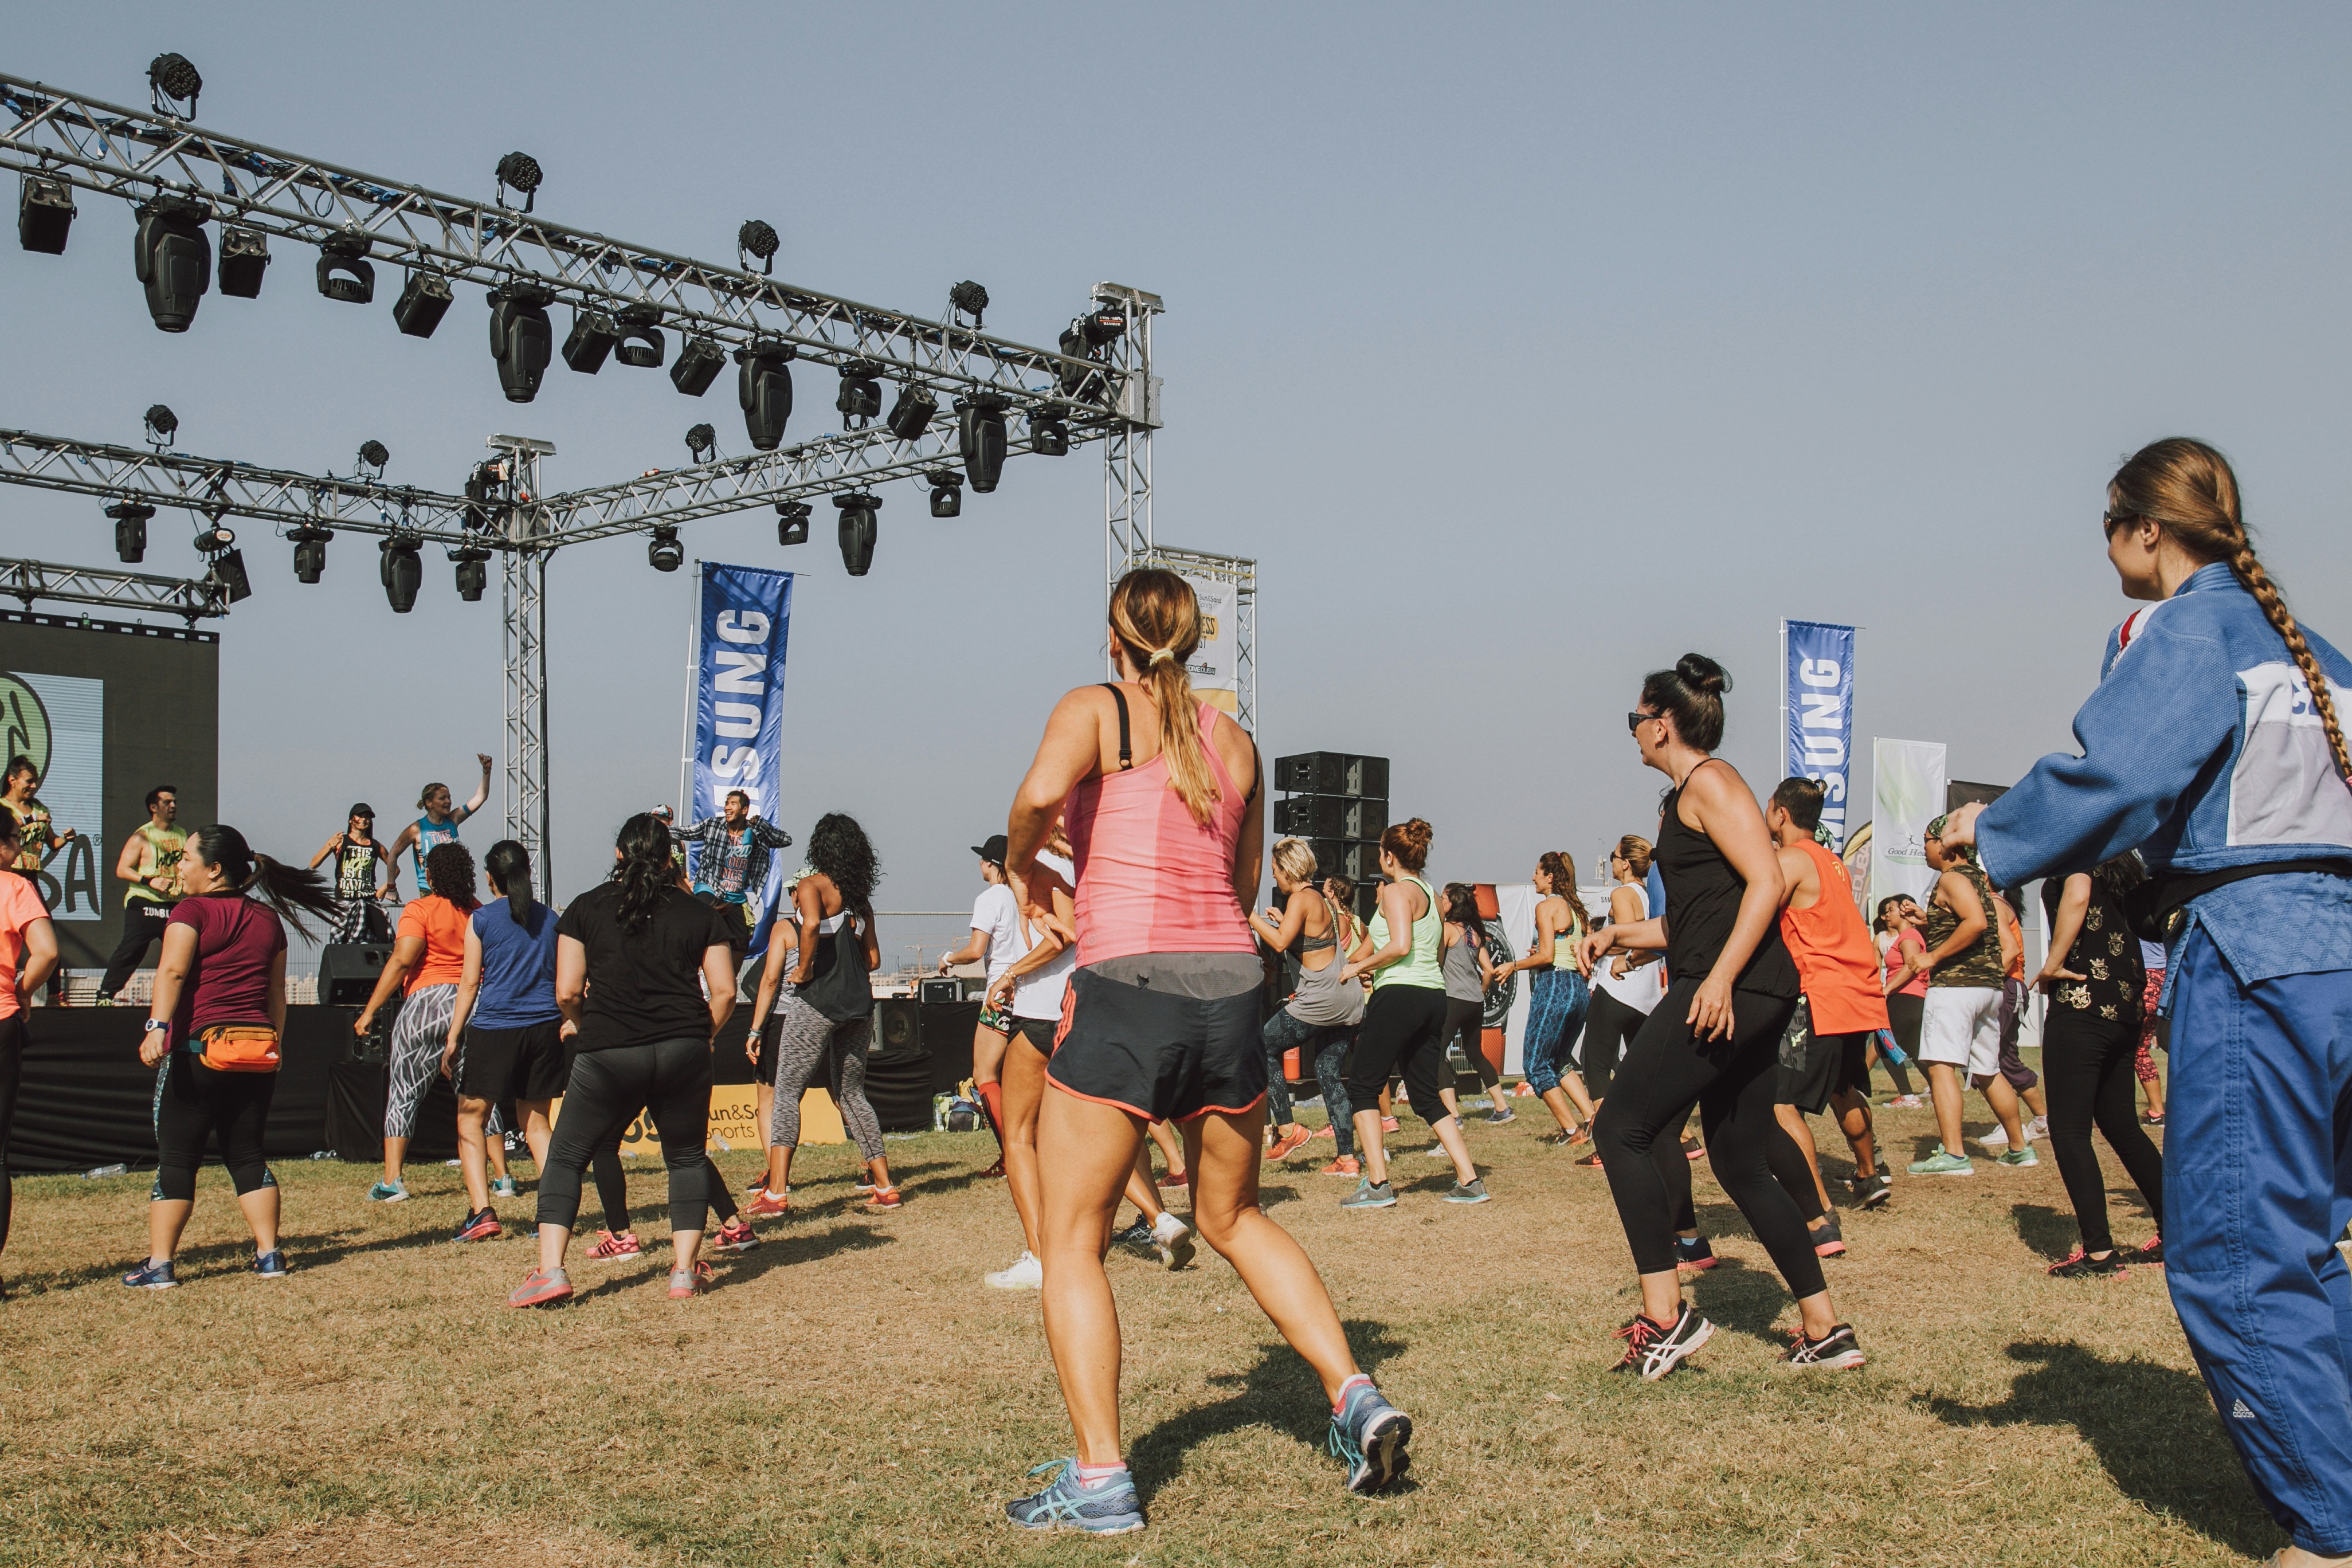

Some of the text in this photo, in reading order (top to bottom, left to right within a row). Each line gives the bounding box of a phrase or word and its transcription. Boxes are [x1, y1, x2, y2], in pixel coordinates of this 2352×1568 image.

[1198, 601, 1213, 609] Sports
[1199, 594, 1222, 604] Sun&Sand
[1201, 617, 1214, 635] ESS
[347, 845, 373, 860] THE
